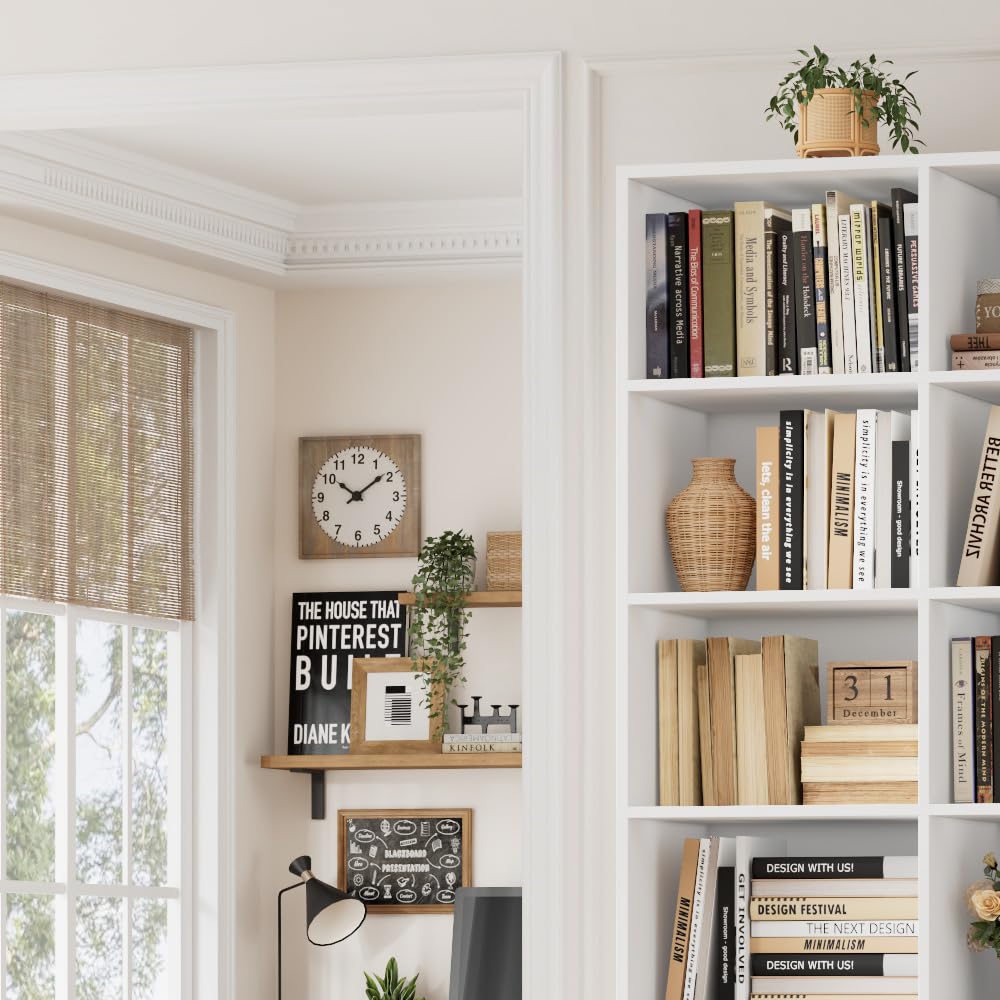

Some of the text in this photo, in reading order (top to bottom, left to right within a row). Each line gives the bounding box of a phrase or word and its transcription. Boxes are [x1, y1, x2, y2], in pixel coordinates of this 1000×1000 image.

[674, 245, 684, 286] Narrative
[855, 248, 863, 281] worlds
[743, 237, 757, 324] Media and Symbols
[676, 320, 685, 344] Media
[967, 337, 990, 349] THEE
[784, 421, 793, 469] simplicity
[334, 460, 345, 470] 11
[352, 454, 364, 464] 12
[373, 460, 378, 470] 1
[323, 474, 336, 484] 10
[386, 472, 393, 482] 2
[785, 472, 793, 481] is
[785, 484, 793, 493] in
[317, 492, 324, 502] 9
[393, 491, 399, 501] 3
[762, 489, 772, 520] clean
[834, 472, 850, 537] MINIMALISM
[323, 511, 329, 521] 8
[386, 511, 392, 521] 4
[784, 496, 793, 548] everything
[335, 525, 341, 535] 7
[355, 531, 361, 541] 6
[373, 525, 380, 535] 5
[762, 523, 772, 543] the
[762, 545, 772, 560] air
[785, 551, 792, 564] we
[298, 600, 400, 620] THE HOUSE THAT
[296, 623, 402, 650] PINTEREST
[843, 675, 895, 702] 3 1
[843, 709, 898, 718] December
[956, 693, 966, 736] Frames
[294, 724, 337, 745] DIANE
[450, 743, 496, 752] KINFOLK
[958, 752, 967, 784] Mind
[766, 863, 854, 873] DESIGN WITH US!
[758, 904, 847, 915] DESIGN FESTIVAL
[806, 922, 915, 934] THE NEXT DESIGN
[804, 939, 866, 951] MINIMALISM
